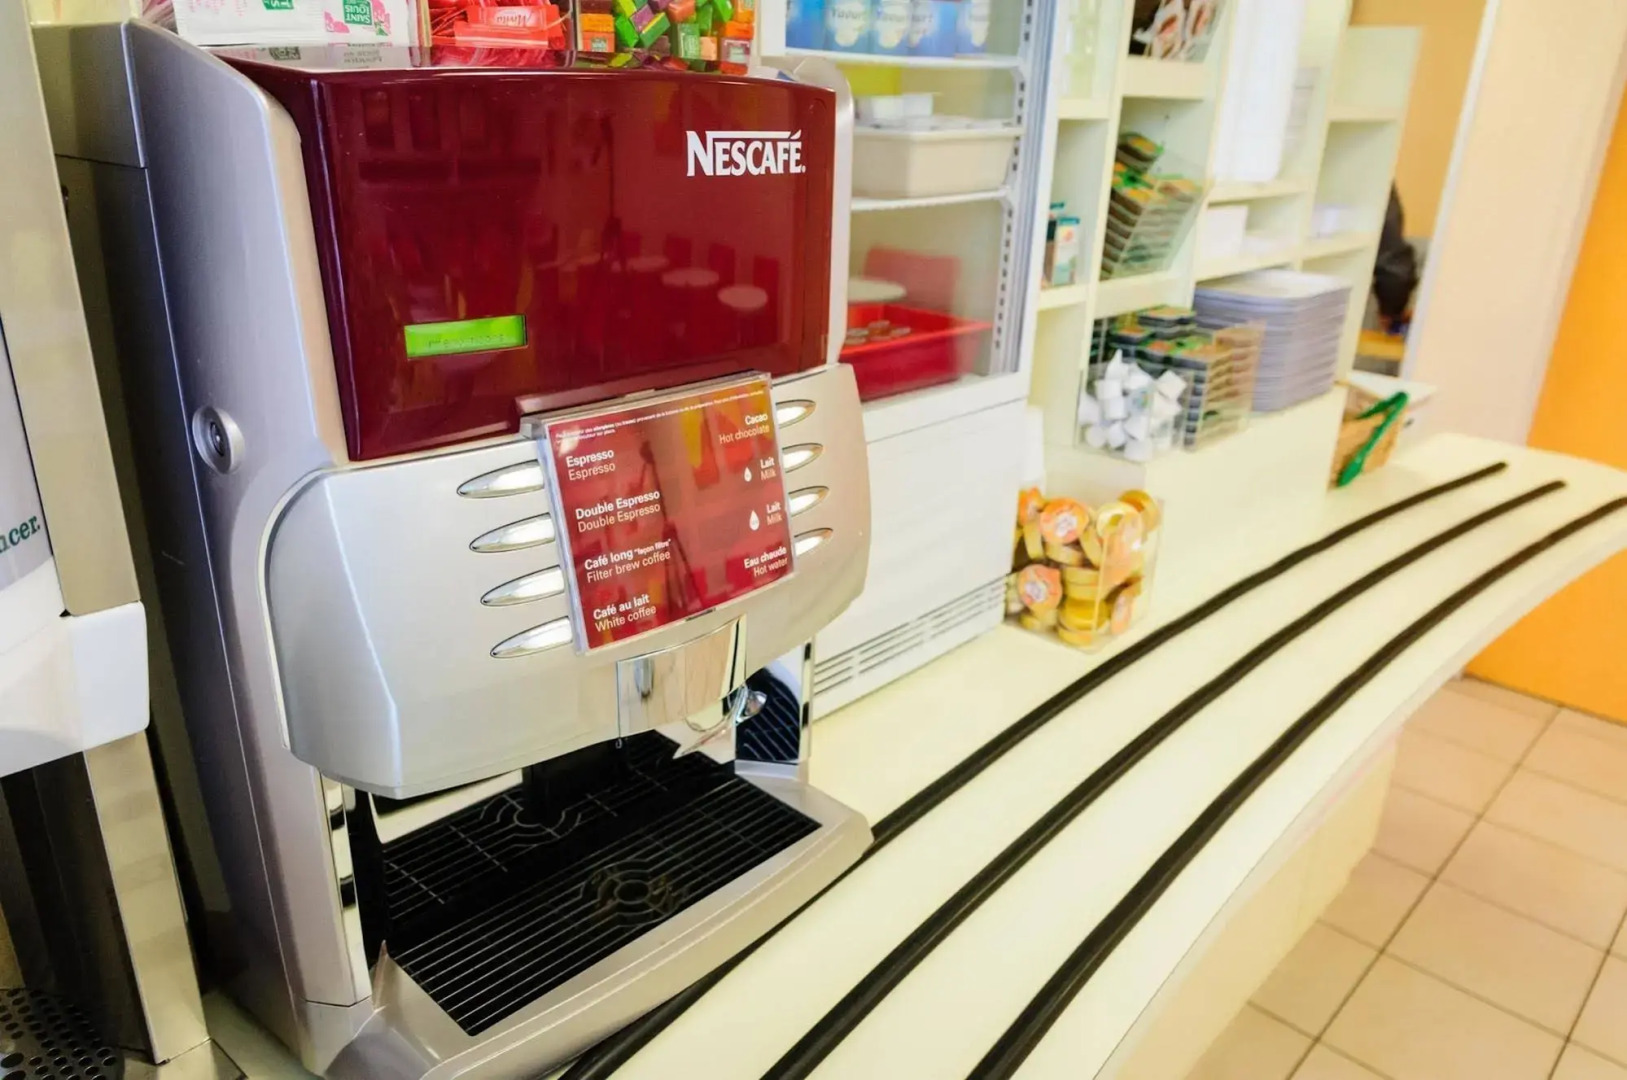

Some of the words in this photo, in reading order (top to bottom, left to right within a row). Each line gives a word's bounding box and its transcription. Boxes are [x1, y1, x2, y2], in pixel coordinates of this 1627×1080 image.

[344, 4, 370, 15] LOUIS
[344, 13, 371, 24] SAINT
[744, 413, 769, 426] Cacao
[719, 433, 734, 445] Hot
[734, 423, 770, 440] chocolate
[566, 449, 615, 468] Espresso
[760, 457, 775, 469] Lait
[568, 462, 616, 481] Espresso
[760, 469, 776, 481] Milk
[575, 501, 614, 520] Double
[615, 490, 661, 510] Espresso
[766, 502, 781, 514] Lait
[577, 514, 615, 533] Double
[617, 503, 661, 523] Espresso
[766, 512, 783, 526] Milk
[584, 555, 609, 571] Café
[610, 549, 634, 564] long
[586, 566, 616, 584] Filter
[615, 560, 640, 575] brew
[641, 550, 671, 567] coffee
[743, 557, 760, 570] Eau
[760, 546, 787, 562] chaude
[753, 566, 768, 578] Hot
[768, 557, 789, 572] water
[593, 604, 617, 620] Café
[619, 601, 633, 612] au
[633, 594, 650, 608] lait
[594, 616, 626, 633] White
[627, 605, 657, 622] coffee
